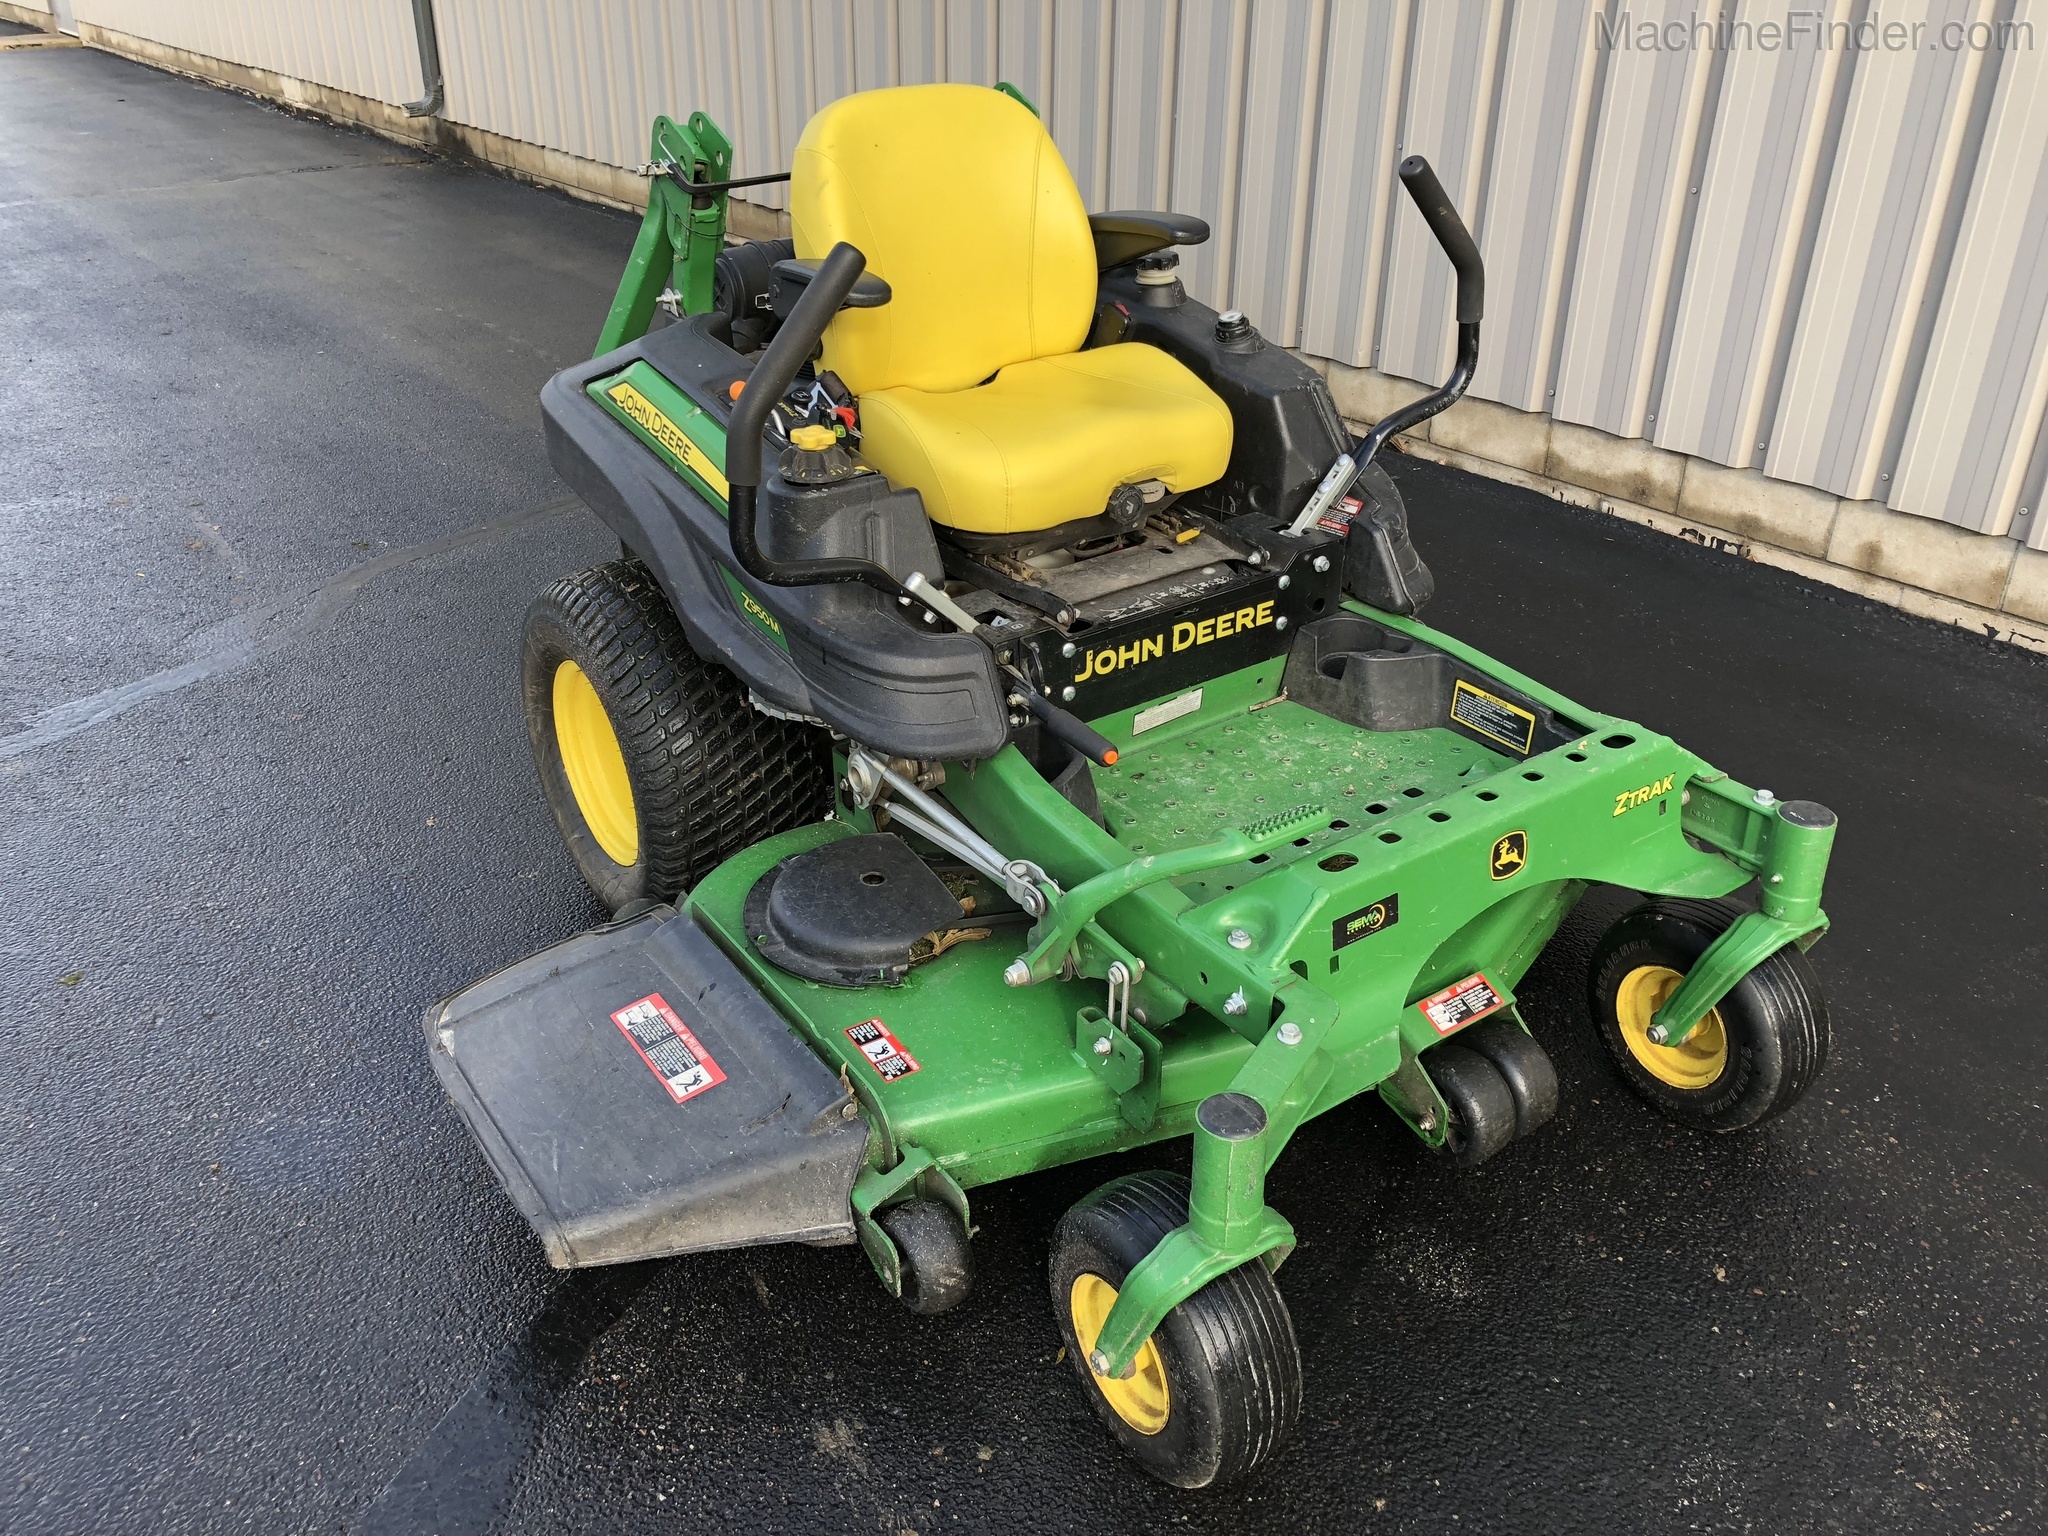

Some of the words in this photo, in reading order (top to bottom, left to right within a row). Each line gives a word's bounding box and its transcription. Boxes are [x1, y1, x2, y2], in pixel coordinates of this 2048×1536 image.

[619, 388, 651, 427] JOHN
[650, 412, 692, 463] DEERE
[1074, 633, 1164, 683] JOHN
[1172, 599, 1275, 653] DEERE
[1612, 772, 1676, 818] ZTRAK
[1347, 910, 1381, 931] SEMA
[664, 1011, 685, 1033] DANGER
[686, 1037, 709, 1061] PELIGRO
